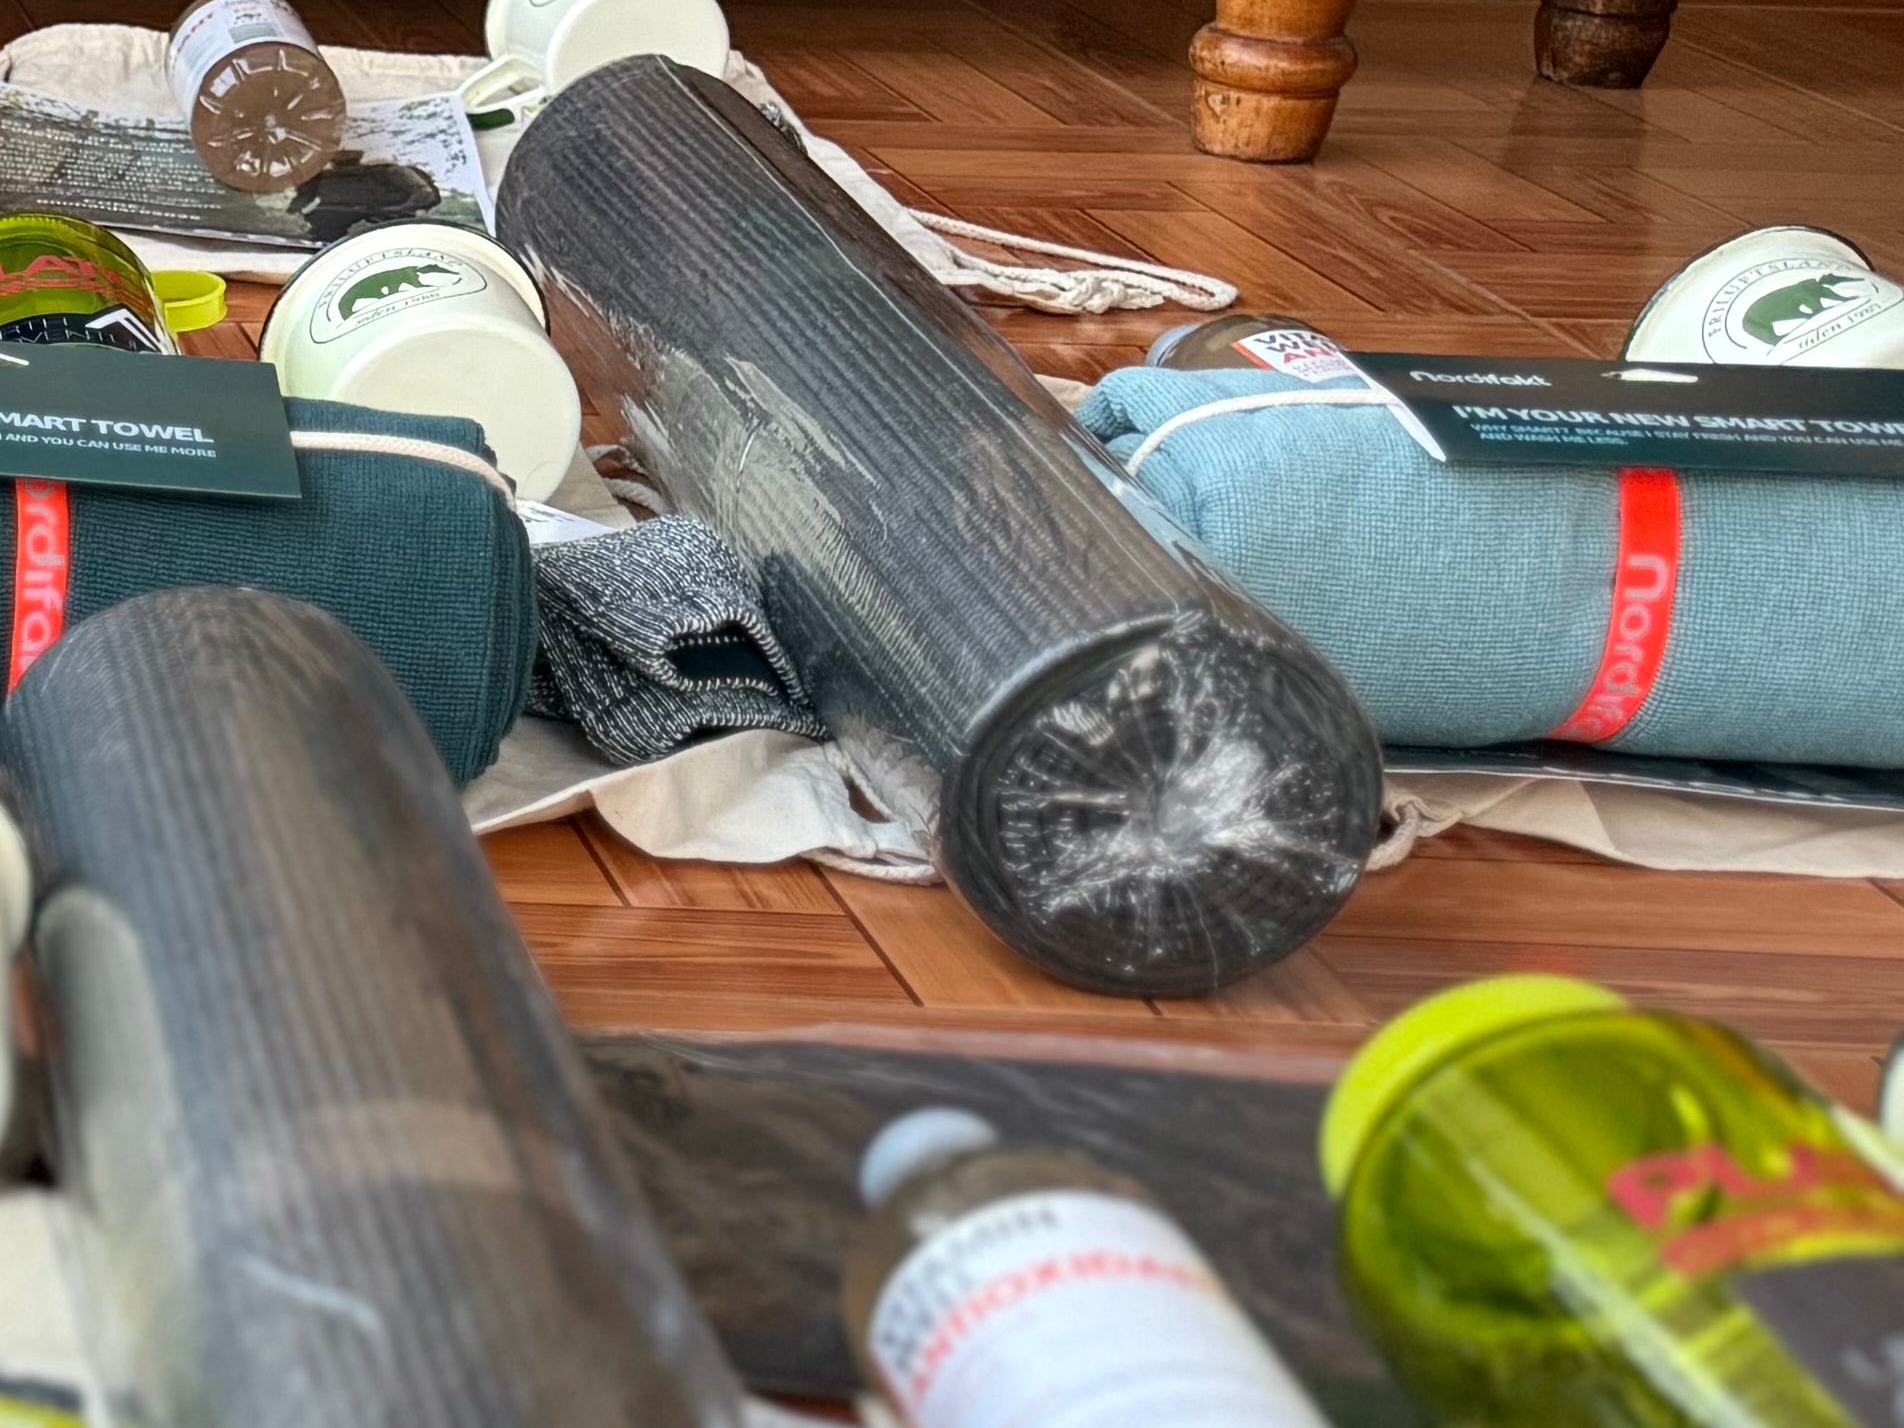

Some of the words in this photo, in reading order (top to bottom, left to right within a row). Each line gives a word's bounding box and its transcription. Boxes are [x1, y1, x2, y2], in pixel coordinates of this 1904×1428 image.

[90, 419, 215, 443] TOWEL
[1506, 407, 1610, 424] YOUR
[1608, 412, 1691, 428] NEW
[1693, 415, 1807, 432] SMART
[5, 432, 39, 443] AND
[41, 435, 74, 447] YOU
[76, 438, 109, 450] CAN
[113, 442, 142, 453] USE
[144, 444, 168, 455] ME
[170, 447, 217, 459] MORE
